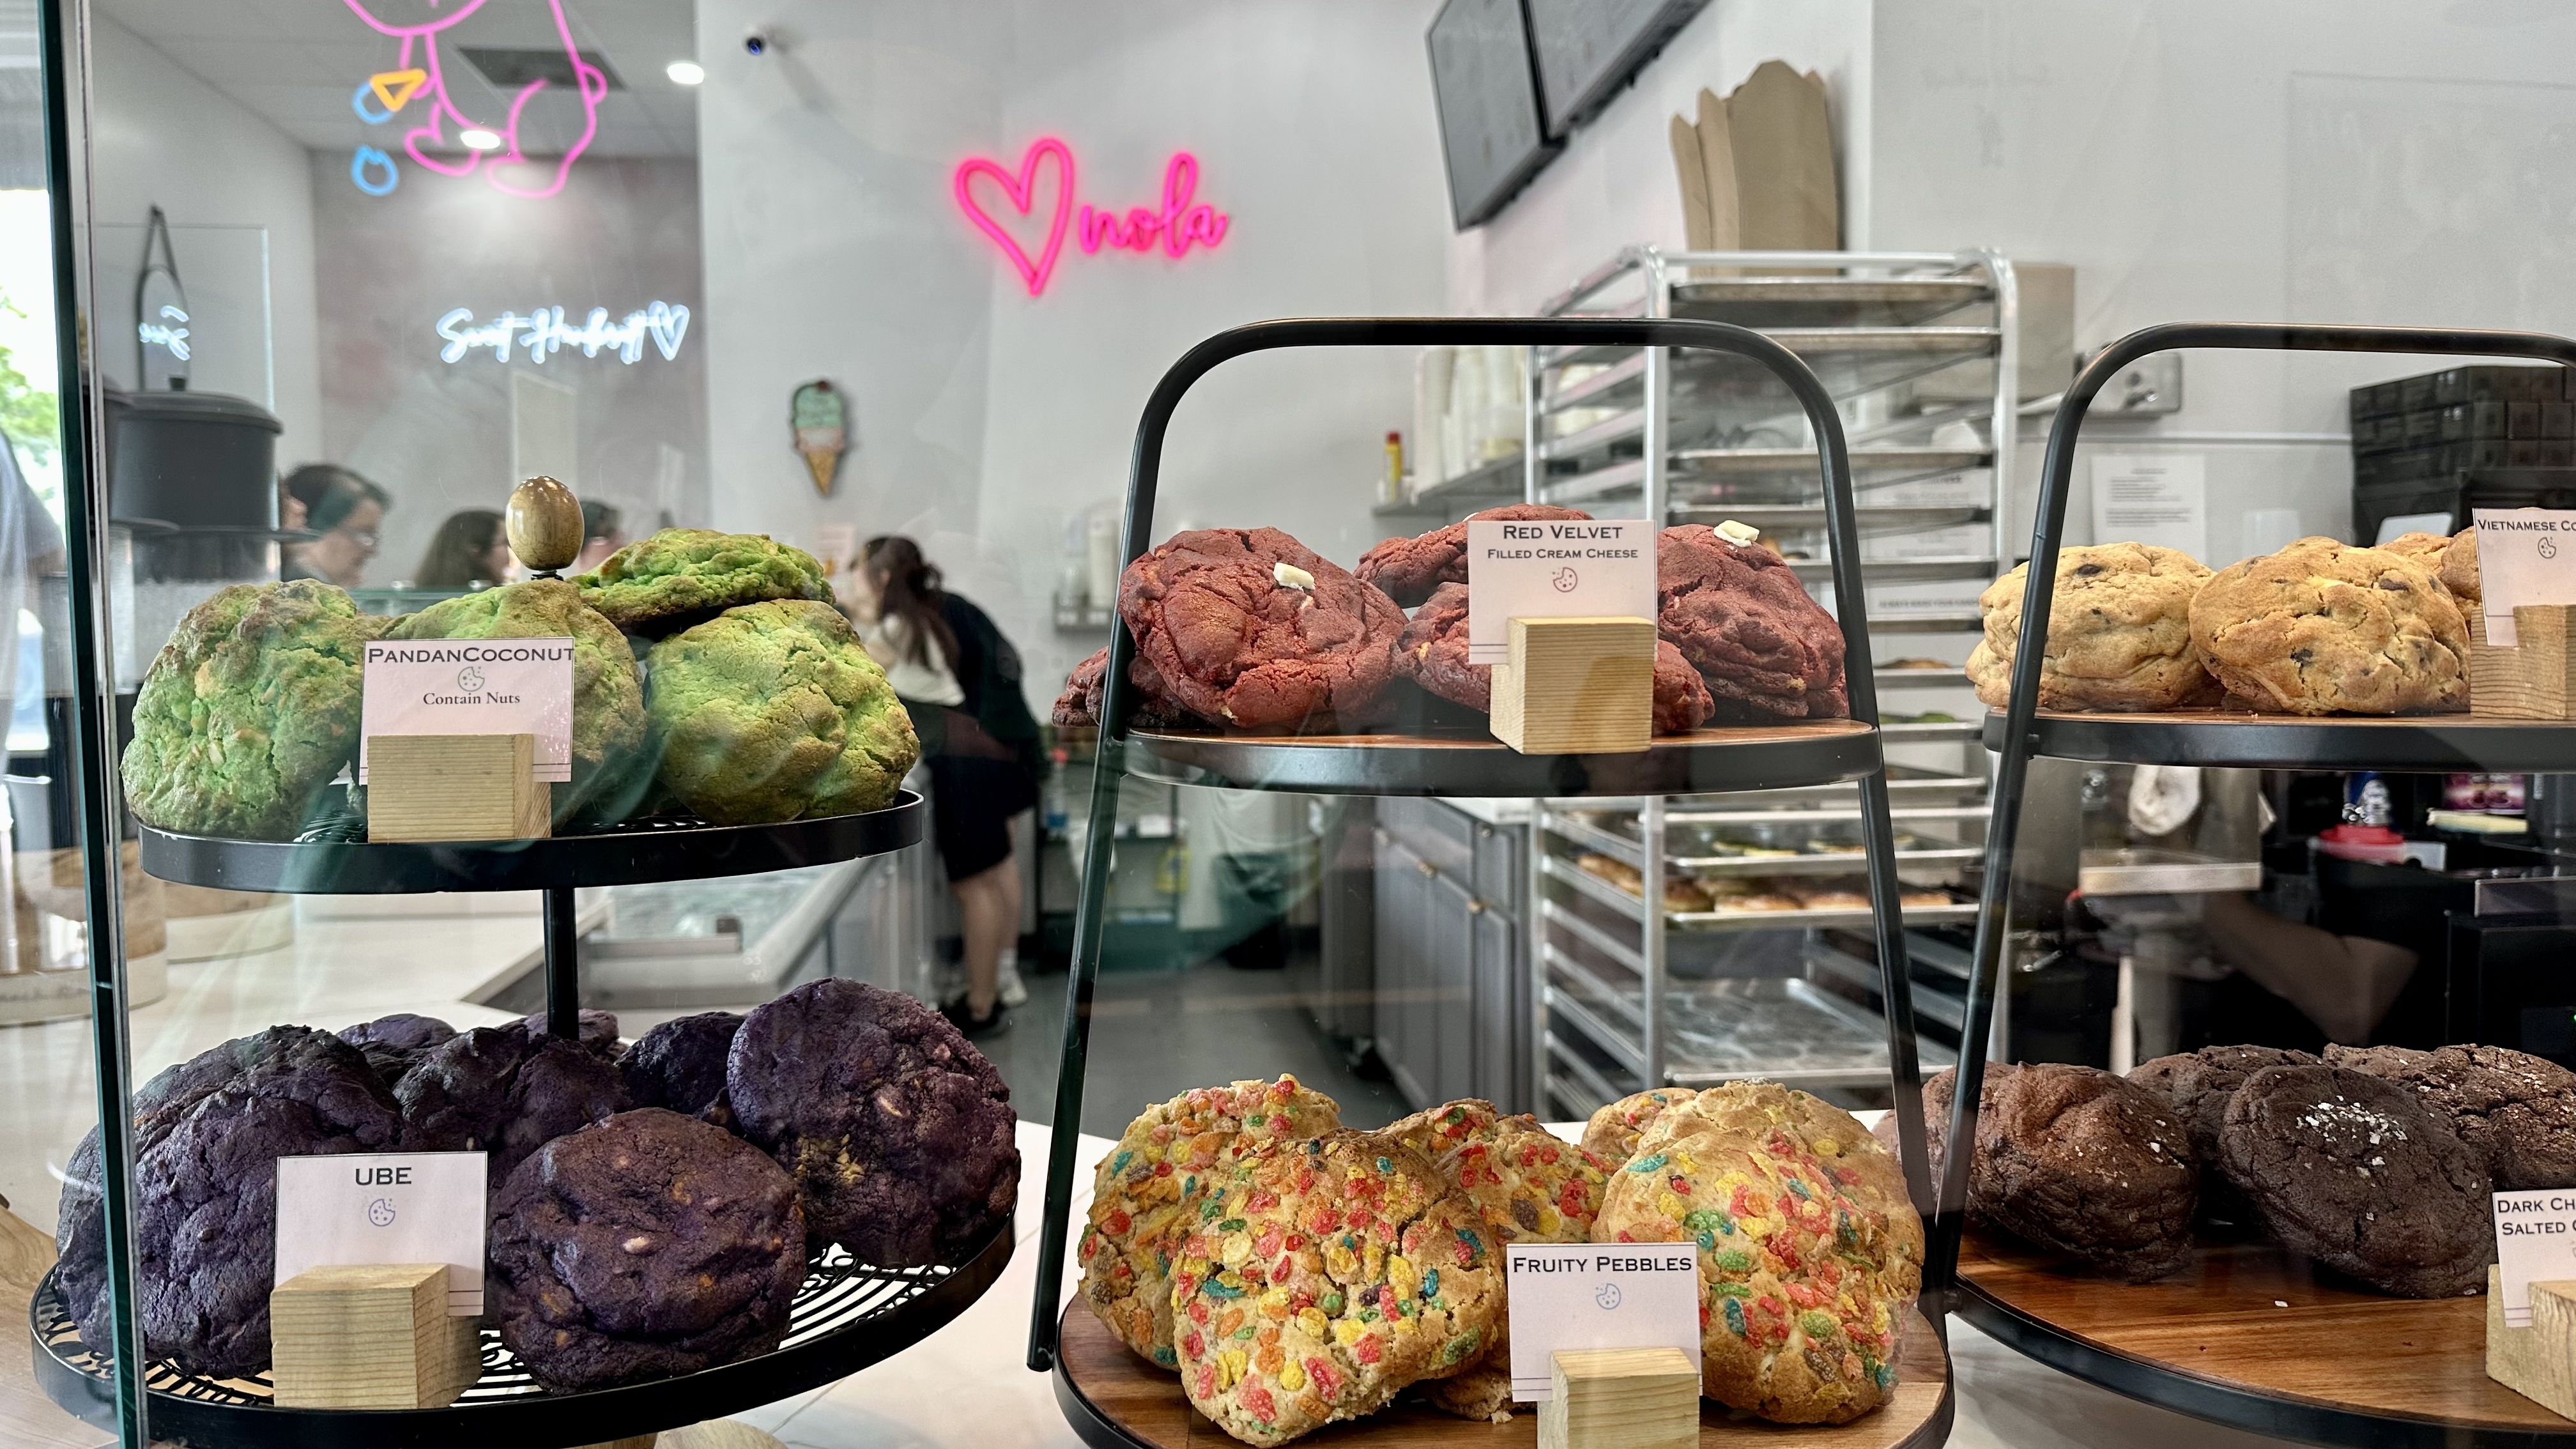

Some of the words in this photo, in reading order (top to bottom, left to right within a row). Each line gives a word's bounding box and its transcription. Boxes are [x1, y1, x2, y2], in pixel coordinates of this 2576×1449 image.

[1078, 151, 1229, 259] nola
[1503, 525, 1542, 539] RED
[1550, 525, 1623, 539] VELVET
[2478, 519, 2557, 532] VIETNAMESE
[1487, 549, 1532, 559] FILLED
[1536, 549, 1581, 558] CREAM
[1586, 549, 1638, 558] CHEESE
[368, 647, 574, 663] PANDANCOCONUT
[423, 693, 481, 705] Contain
[486, 692, 521, 704] Nuts
[355, 1167, 412, 1186] UBE
[2497, 1200, 2544, 1213] DARK
[2502, 1222, 2566, 1236] SALTED
[1514, 1257, 1588, 1273] FRUITY
[1596, 1256, 1692, 1272] PEBBLES
